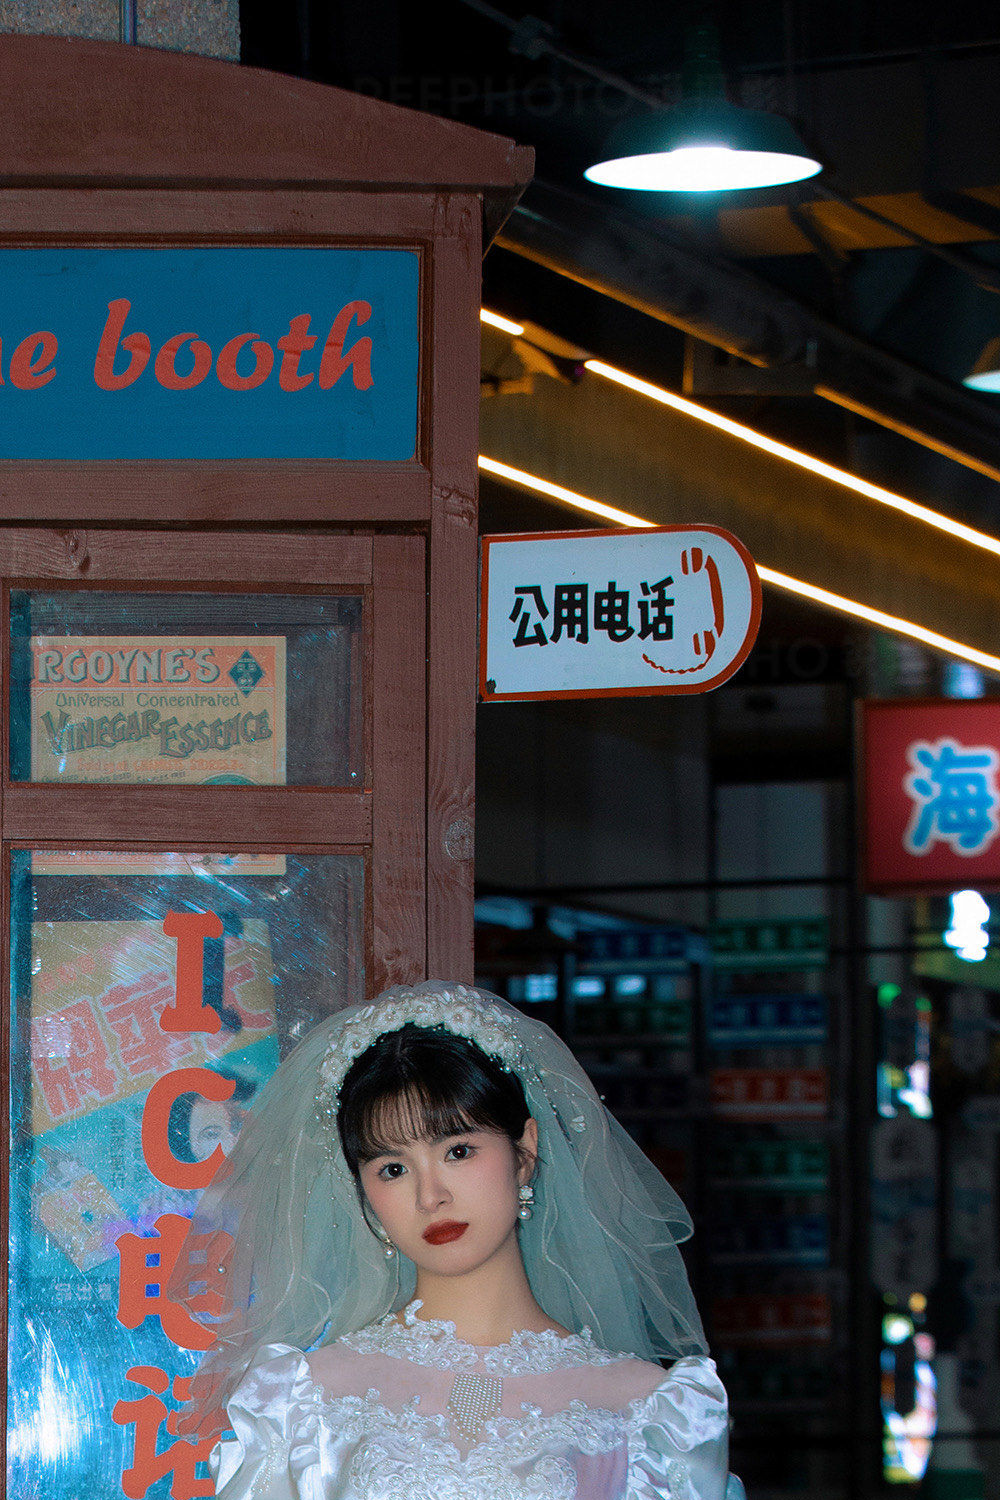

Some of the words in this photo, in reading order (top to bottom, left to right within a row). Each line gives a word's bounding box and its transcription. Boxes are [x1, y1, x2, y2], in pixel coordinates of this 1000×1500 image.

[94, 298, 375, 392] booth
[508, 577, 675, 647] 公用电话
[32, 649, 221, 684] RGOYNE'S
[56, 692, 125, 707] Universal
[136, 692, 240, 707] Concentrated
[41, 709, 163, 756] VINEGAR
[159, 709, 273, 759] ESSENCE
[906, 739, 998, 857] 海
